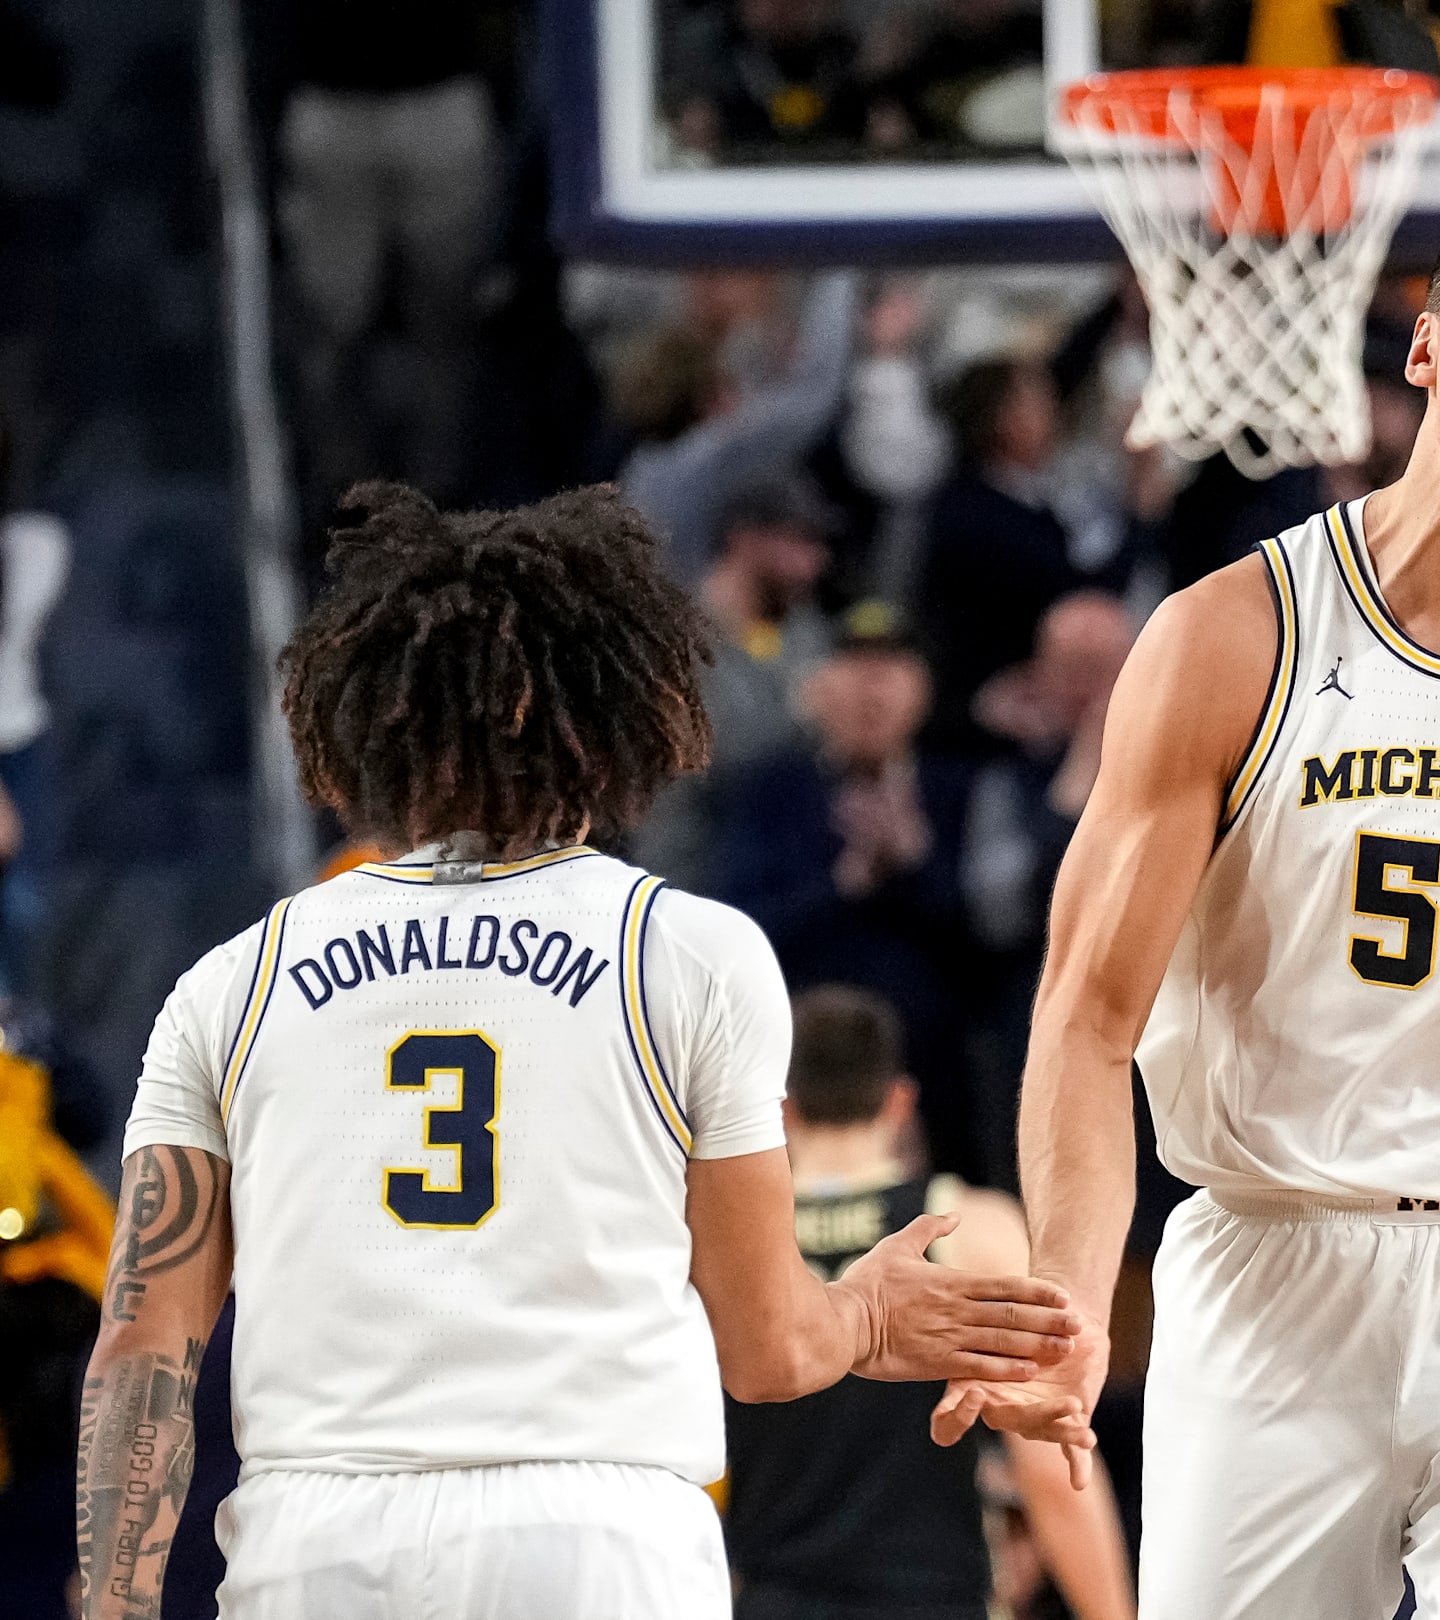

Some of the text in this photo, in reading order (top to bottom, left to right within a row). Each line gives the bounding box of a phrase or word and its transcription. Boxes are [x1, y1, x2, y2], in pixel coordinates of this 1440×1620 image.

[287, 915, 610, 1011] DONALDSON
[381, 1029, 502, 1231] 3
[130, 1423, 157, 1472] GOD
